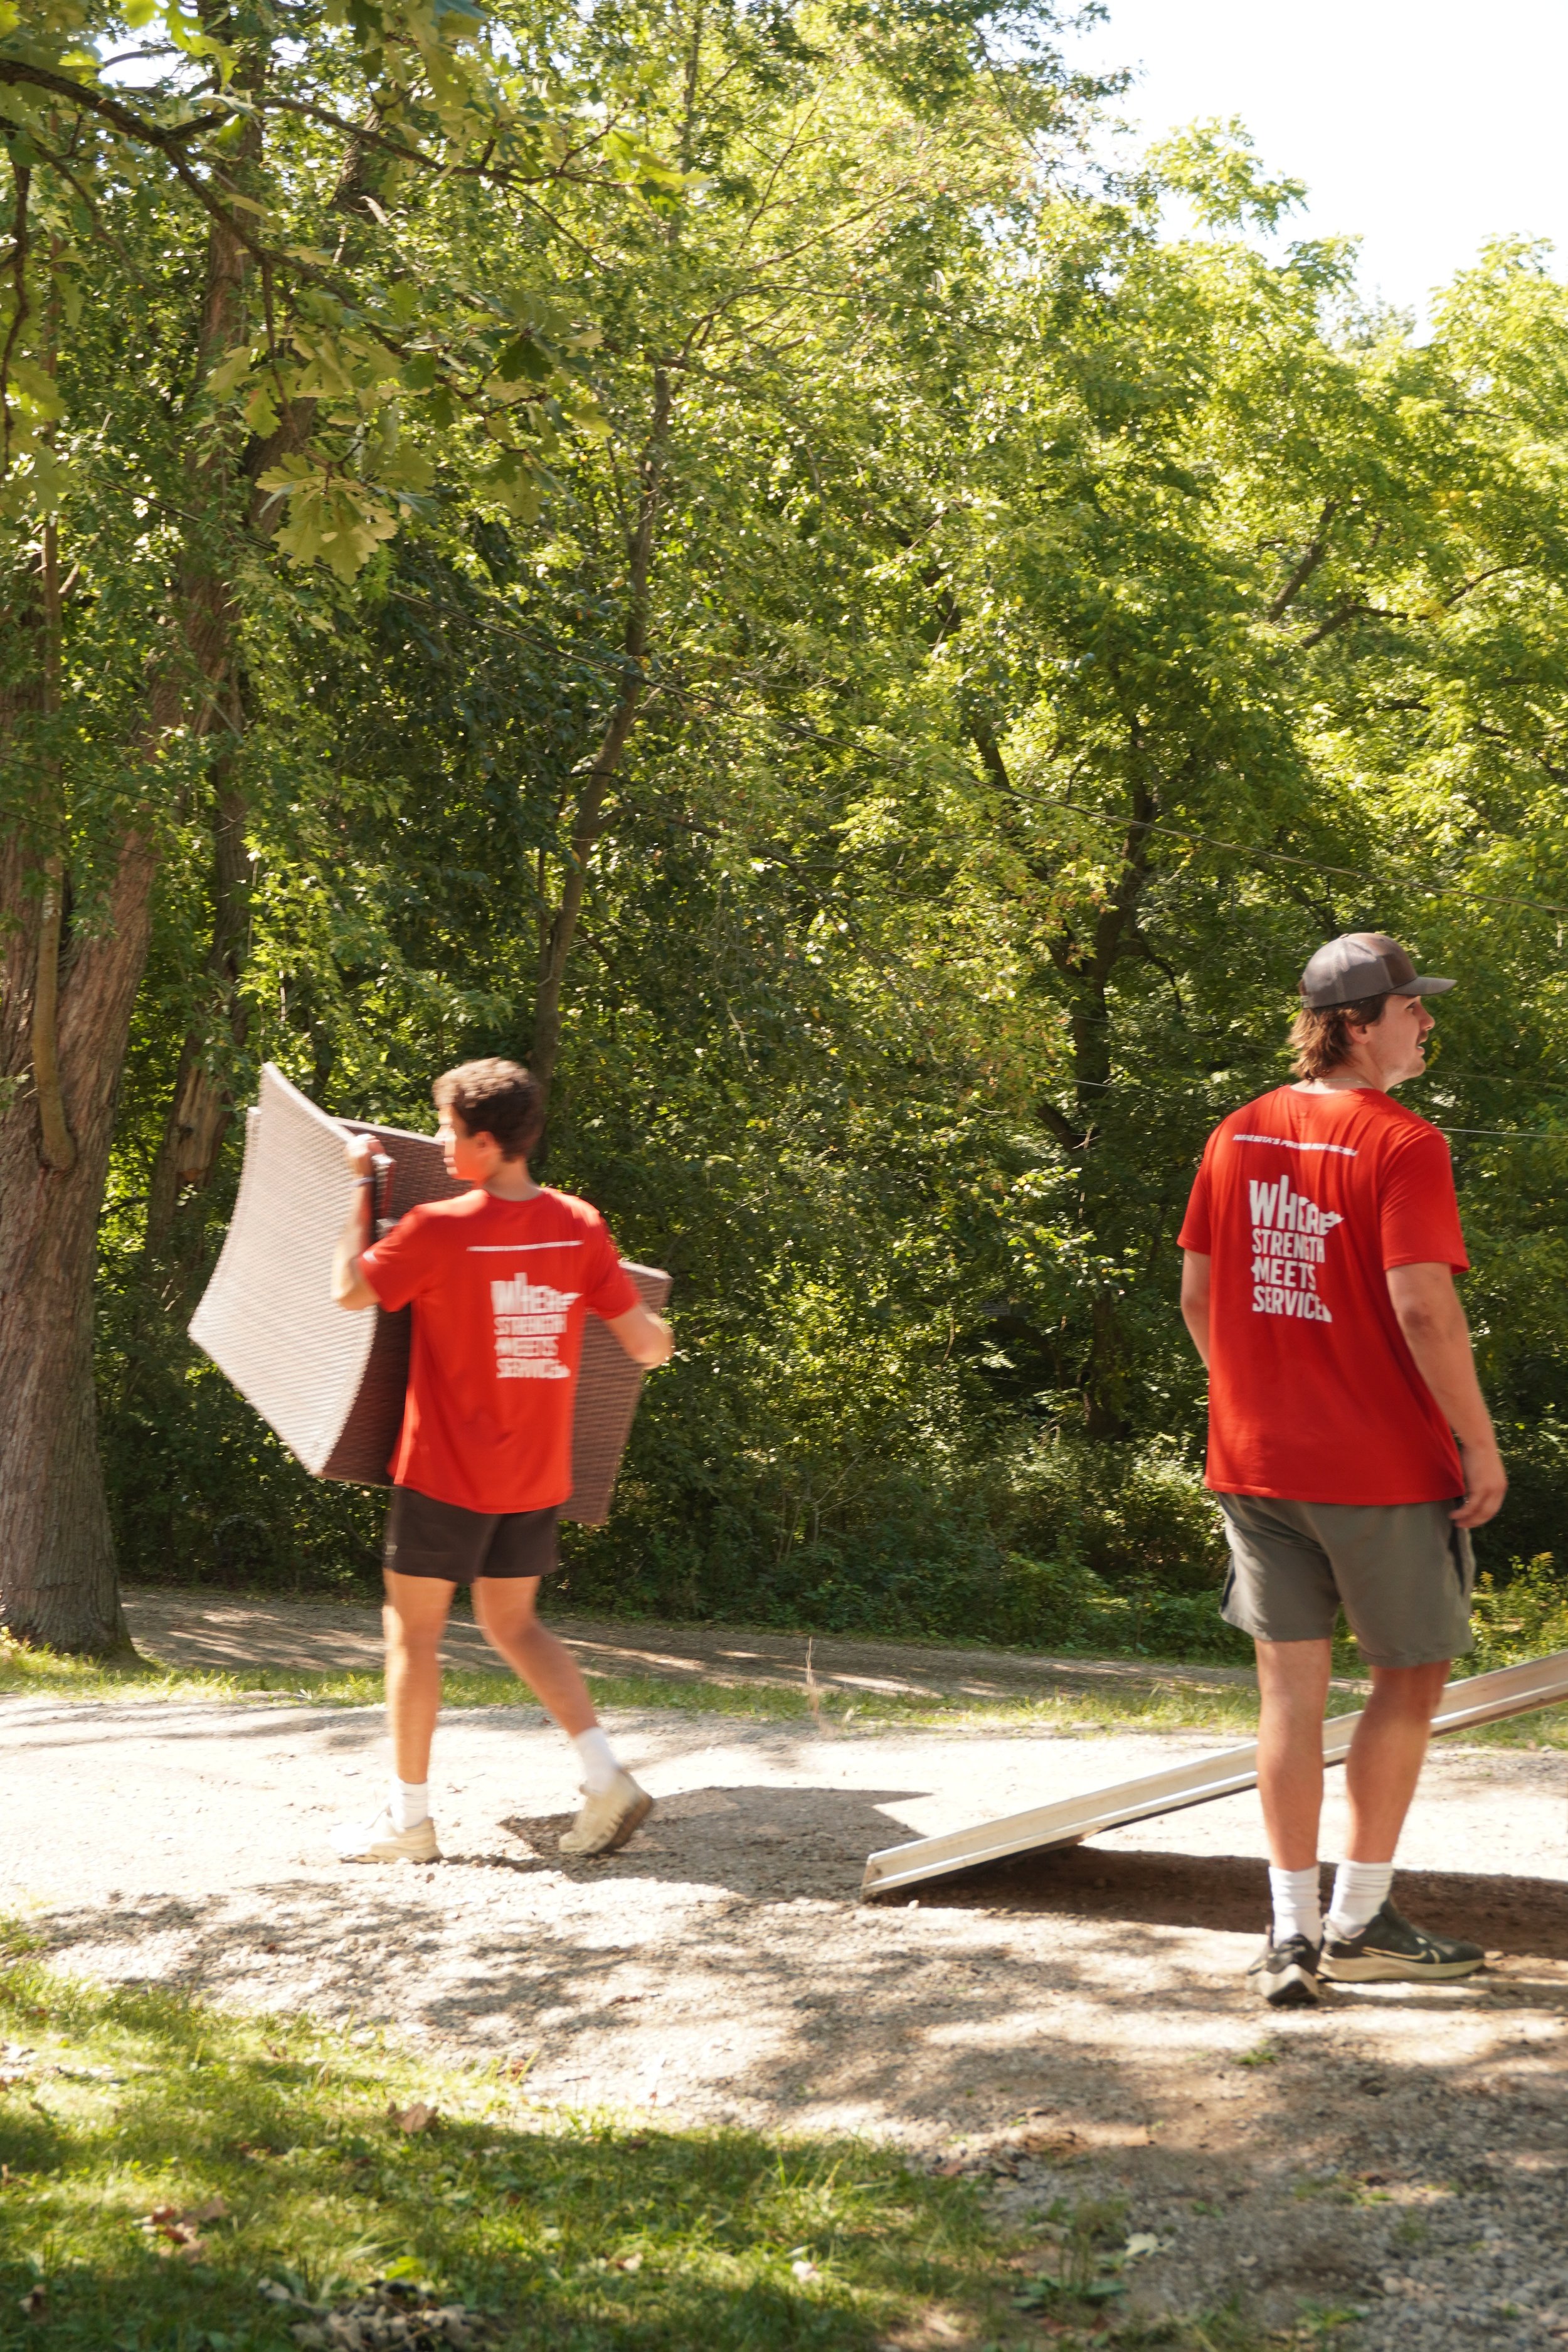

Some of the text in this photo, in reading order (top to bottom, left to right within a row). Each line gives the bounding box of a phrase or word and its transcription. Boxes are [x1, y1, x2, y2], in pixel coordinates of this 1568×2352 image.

[1249, 1174, 1345, 1236] WHERE
[1251, 1227, 1325, 1263] STRENGTH
[1251, 1256, 1316, 1291] MEETS
[1252, 1285, 1333, 1323] SERVICE
